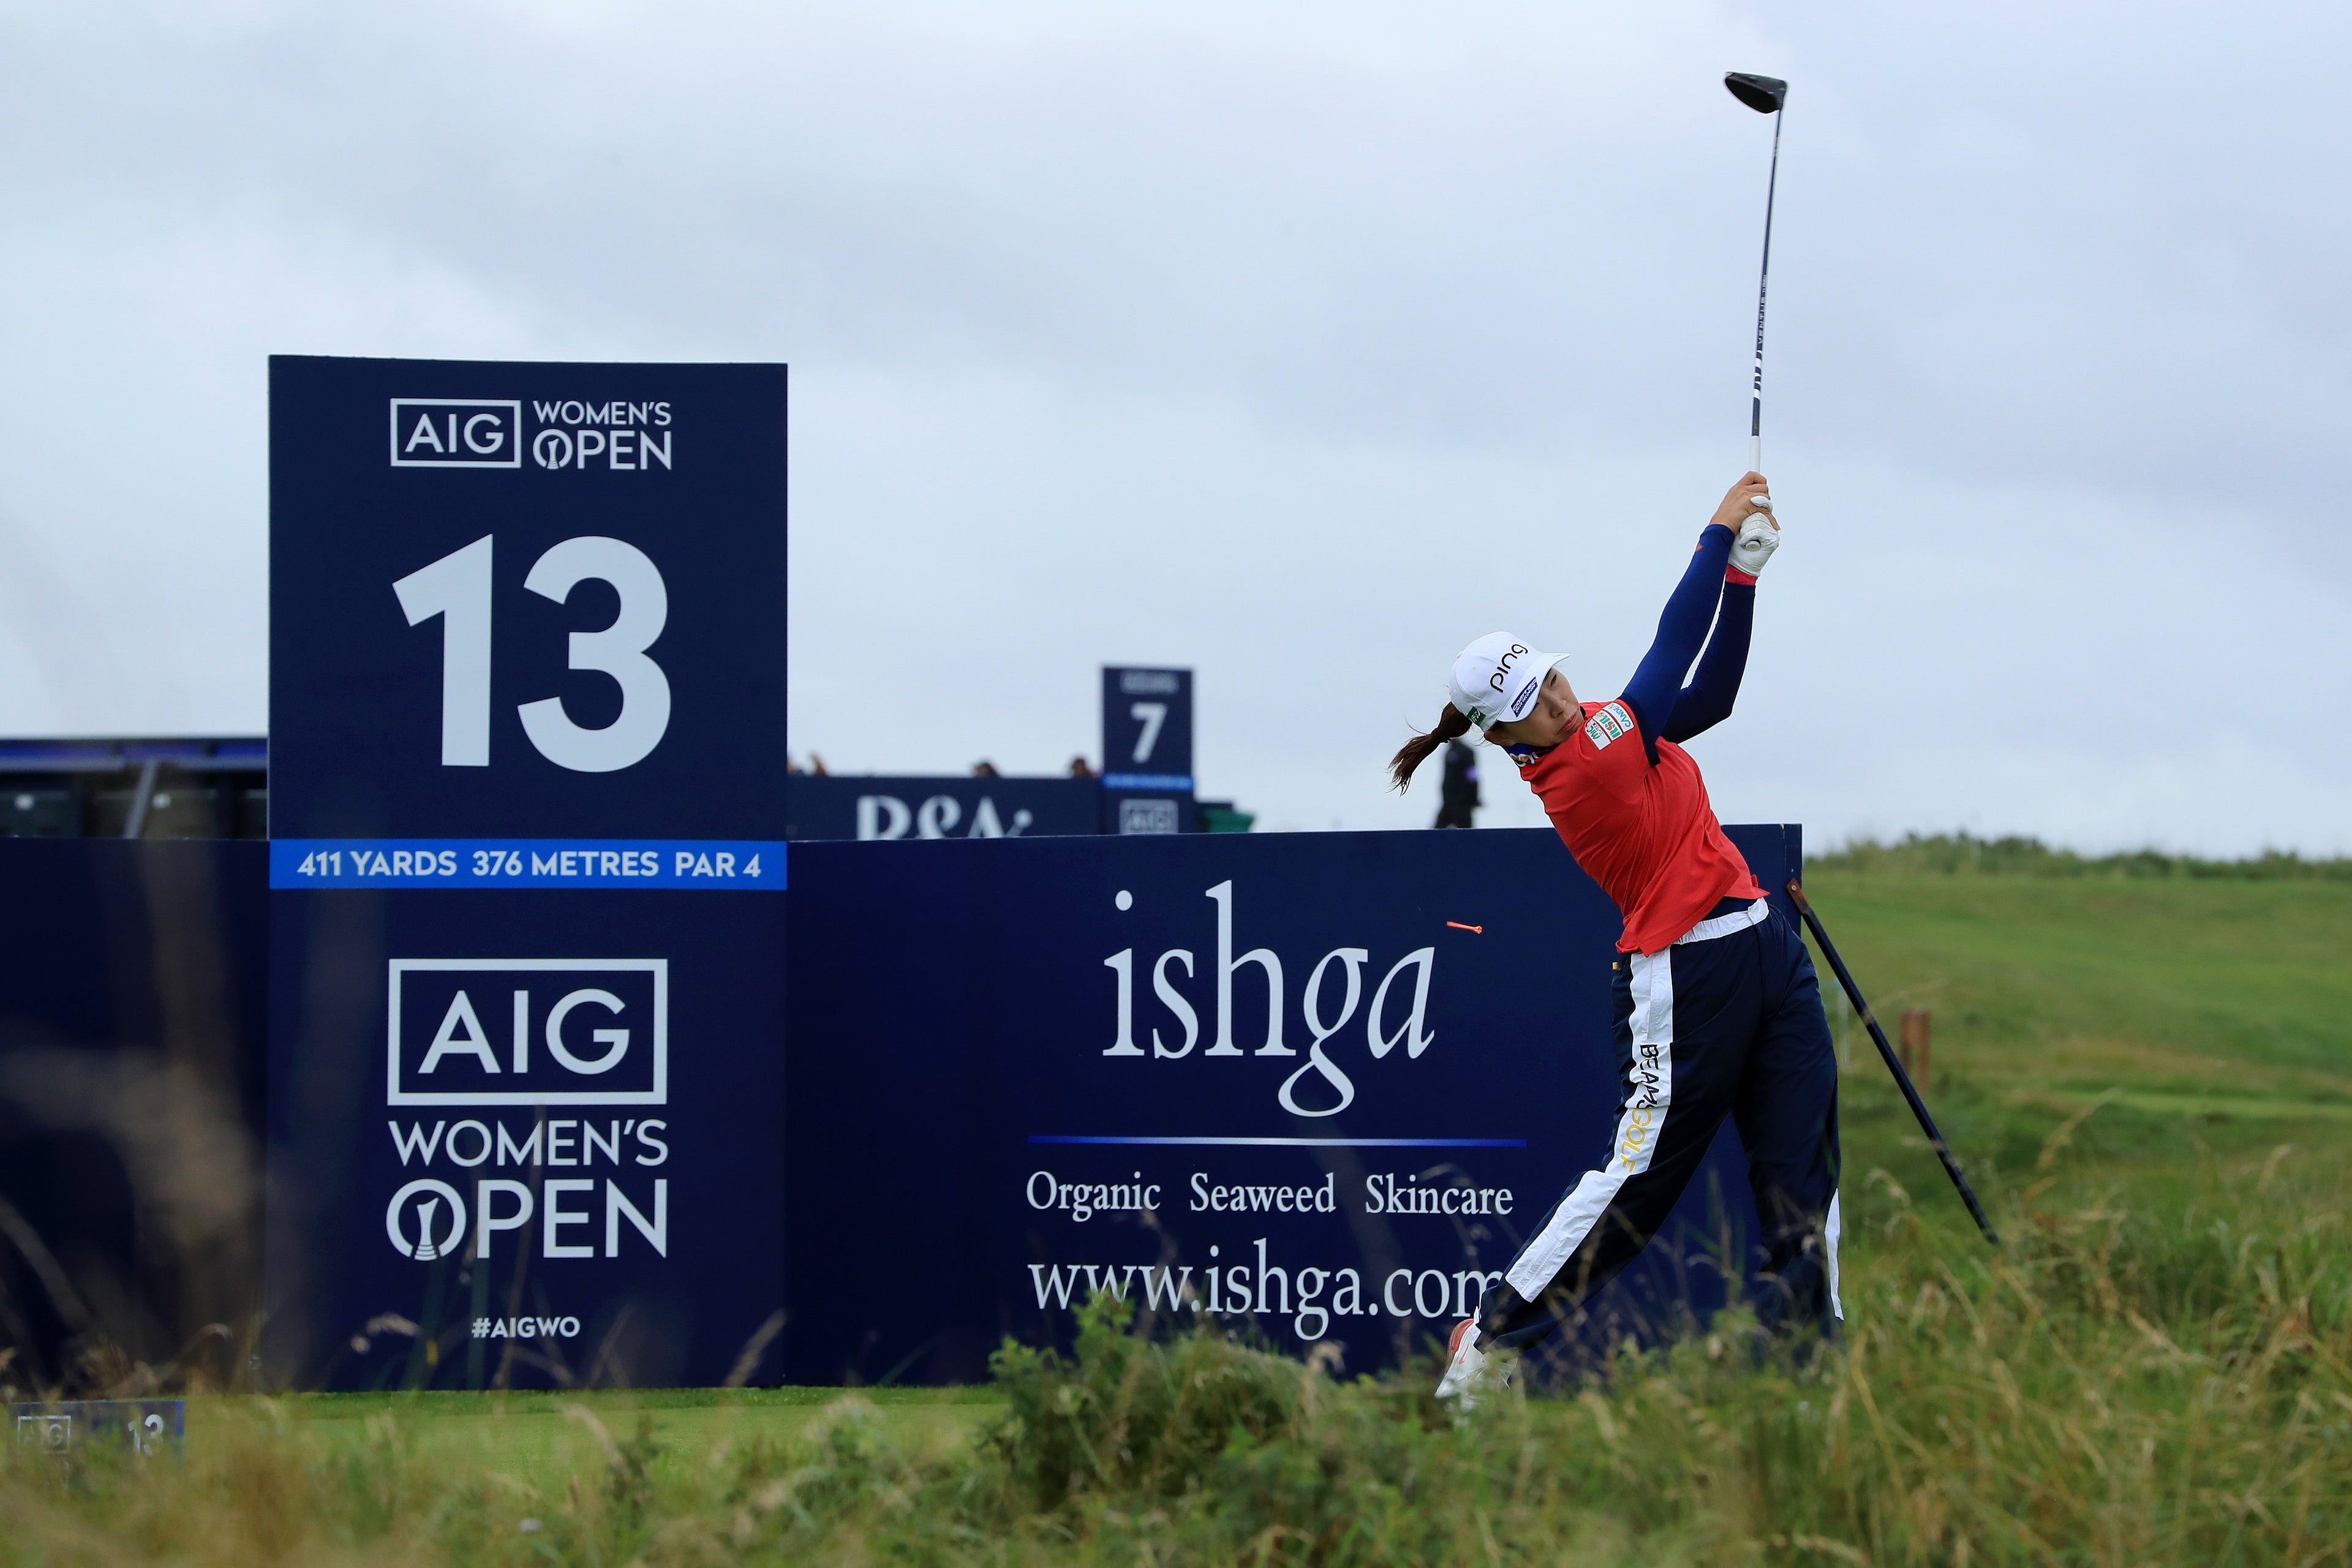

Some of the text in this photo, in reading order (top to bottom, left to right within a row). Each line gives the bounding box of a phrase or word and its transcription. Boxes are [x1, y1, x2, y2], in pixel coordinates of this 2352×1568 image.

[404, 400, 672, 454] AIG WOMEN'S
[532, 429, 672, 470] OPEN
[392, 533, 671, 773] 13
[1490, 644, 1528, 693] ping
[1131, 703, 1168, 763] 7
[1586, 725, 1600, 740] MIC
[298, 850, 762, 878] 411 YARDS 376 METRES PAR 4
[1102, 880, 1435, 1117] ishga
[418, 988, 630, 1075] AIG
[388, 1119, 669, 1167] WOMEN'S
[1619, 1108, 1652, 1173] GOLF
[386, 1178, 668, 1261] OPEN
[1027, 1171, 1513, 1223] Organic Seaweed Skincare
[471, 1316, 581, 1338] #AIGWO
